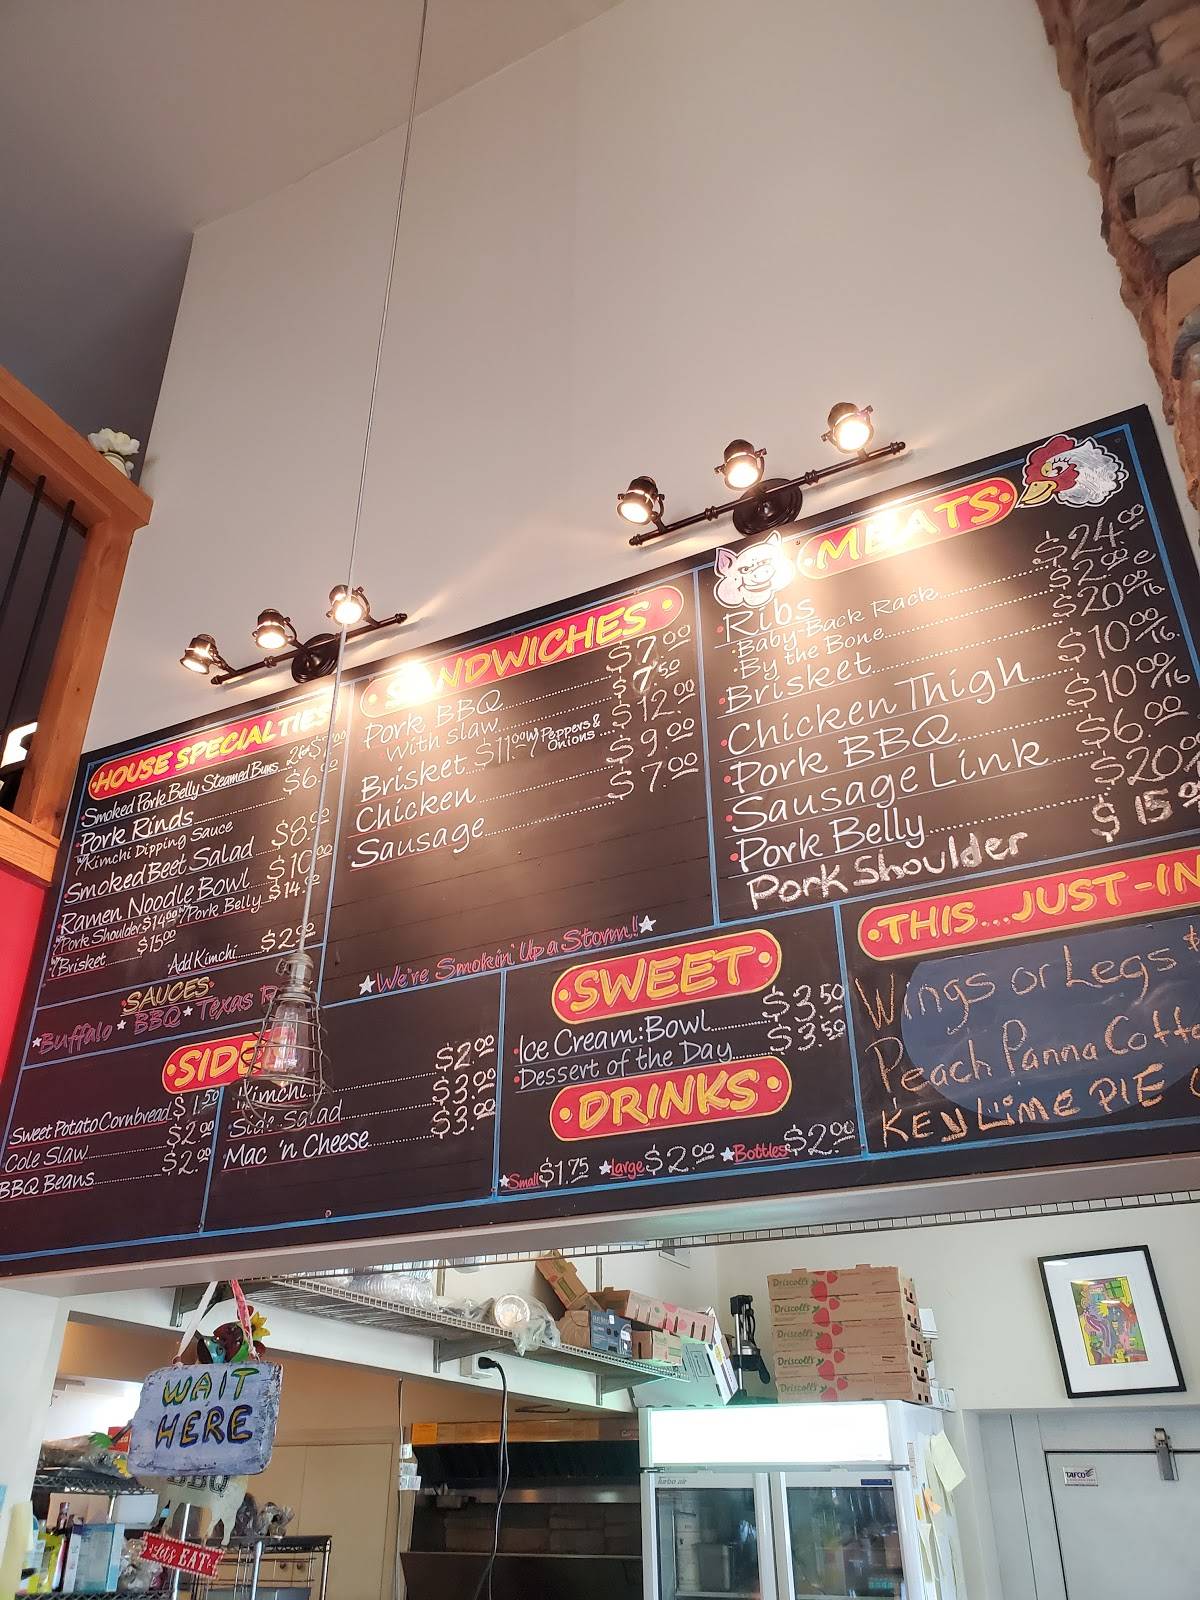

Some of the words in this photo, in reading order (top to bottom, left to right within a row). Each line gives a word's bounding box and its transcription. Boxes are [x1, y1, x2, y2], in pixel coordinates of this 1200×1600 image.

[871, 586, 939, 618] Rack
[1031, 503, 1145, 567] $24.00
[722, 598, 817, 643] Ribs
[612, 658, 681, 699] $7.50
[725, 651, 872, 714] Brisket
[739, 657, 778, 681] By
[783, 644, 820, 666] the
[823, 625, 886, 656] Bone
[364, 712, 425, 749] Pork
[435, 689, 504, 728] BBQ
[606, 624, 691, 674] $7.00
[727, 697, 897, 756] Chicken
[893, 656, 1029, 712] Thigh
[94, 751, 174, 792] HOUSE
[360, 755, 468, 802] Brisket
[540, 720, 592, 743] Peppers
[592, 713, 601, 729] &
[612, 678, 696, 729] $12.00
[547, 730, 596, 752] Onions
[730, 746, 829, 794] Pork
[837, 713, 960, 769] BBQ
[731, 765, 919, 833] Sausage
[929, 737, 1050, 789] Link
[1075, 695, 1190, 750] $6.00
[81, 797, 134, 828] Smoked
[137, 789, 167, 812] Pork
[168, 781, 201, 808] Belly
[202, 767, 251, 792] Steamed
[250, 760, 279, 779] Buns
[355, 786, 477, 832] Chicken
[606, 717, 695, 763] $9.00
[79, 830, 126, 854] Pork
[132, 807, 194, 834] Rinds
[135, 834, 187, 859] Dipping
[190, 821, 234, 843] Sauce
[351, 816, 485, 868] Sausage
[607, 751, 699, 801] $7.00
[735, 827, 824, 873] Pork
[828, 807, 926, 850] Belly
[64, 864, 145, 905] Smoked
[146, 853, 188, 884] Beet
[188, 836, 257, 874] Salad
[271, 807, 330, 850] $8.00
[853, 831, 1028, 887] Shoulder
[60, 907, 123, 935] Ramen
[127, 882, 195, 919] Noodle
[195, 867, 250, 902] Bowl
[91, 921, 142, 945] Shoulder
[223, 892, 262, 914] Belly
[168, 951, 192, 975] Add
[193, 944, 238, 970] Kimchi
[375, 965, 430, 993] We're
[519, 939, 546, 964] Up
[546, 939, 560, 956] a
[560, 915, 640, 951] Storm!
[569, 945, 756, 1013] SWEET
[122, 976, 210, 1012] SAUCES
[855, 971, 996, 1036] Wings
[1010, 963, 1051, 996] or
[1062, 944, 1177, 1006] Legs
[39, 1022, 113, 1055] Buffalo
[133, 1005, 182, 1035] BBQ
[196, 992, 254, 1022] Texas
[435, 1034, 495, 1072] $2.00
[518, 1035, 549, 1067] Ice
[643, 1009, 712, 1043] Bowl
[762, 983, 845, 1023] $3.50
[518, 1058, 601, 1091] Dessert
[606, 1050, 631, 1077] of
[635, 1047, 673, 1074] the
[682, 1039, 734, 1067] Day
[766, 1018, 847, 1056] $3.50
[864, 1036, 993, 1093] Peach
[1002, 1018, 1098, 1077] Panna
[12, 1127, 51, 1147] Sweet
[54, 1117, 99, 1138] Potato
[99, 1101, 171, 1131] Cornbread
[173, 1090, 220, 1119] $1.50
[282, 1099, 343, 1131] Salad
[432, 1067, 497, 1107] $3.00
[578, 1067, 762, 1131] DRINKS
[1088, 1062, 1166, 1114] PIE
[5, 1152, 39, 1174] Cole
[43, 1145, 89, 1171] Slaw
[166, 1118, 216, 1151] $2.00
[223, 1143, 268, 1169] Mac
[302, 1129, 369, 1159] Cheese
[430, 1098, 497, 1140] $3.00
[509, 1172, 540, 1191] Small
[538, 1157, 590, 1189] $1.75
[644, 1142, 716, 1176] $2.00
[733, 1142, 789, 1165] Bottles
[782, 1119, 856, 1157] $2.00
[0, 1176, 39, 1199] BBQ
[43, 1171, 95, 1194] Beans
[161, 1147, 212, 1176] $2.00
[162, 1367, 259, 1408] WAIT
[156, 1404, 253, 1449] HERE
[177, 1548, 210, 1572] EAT
